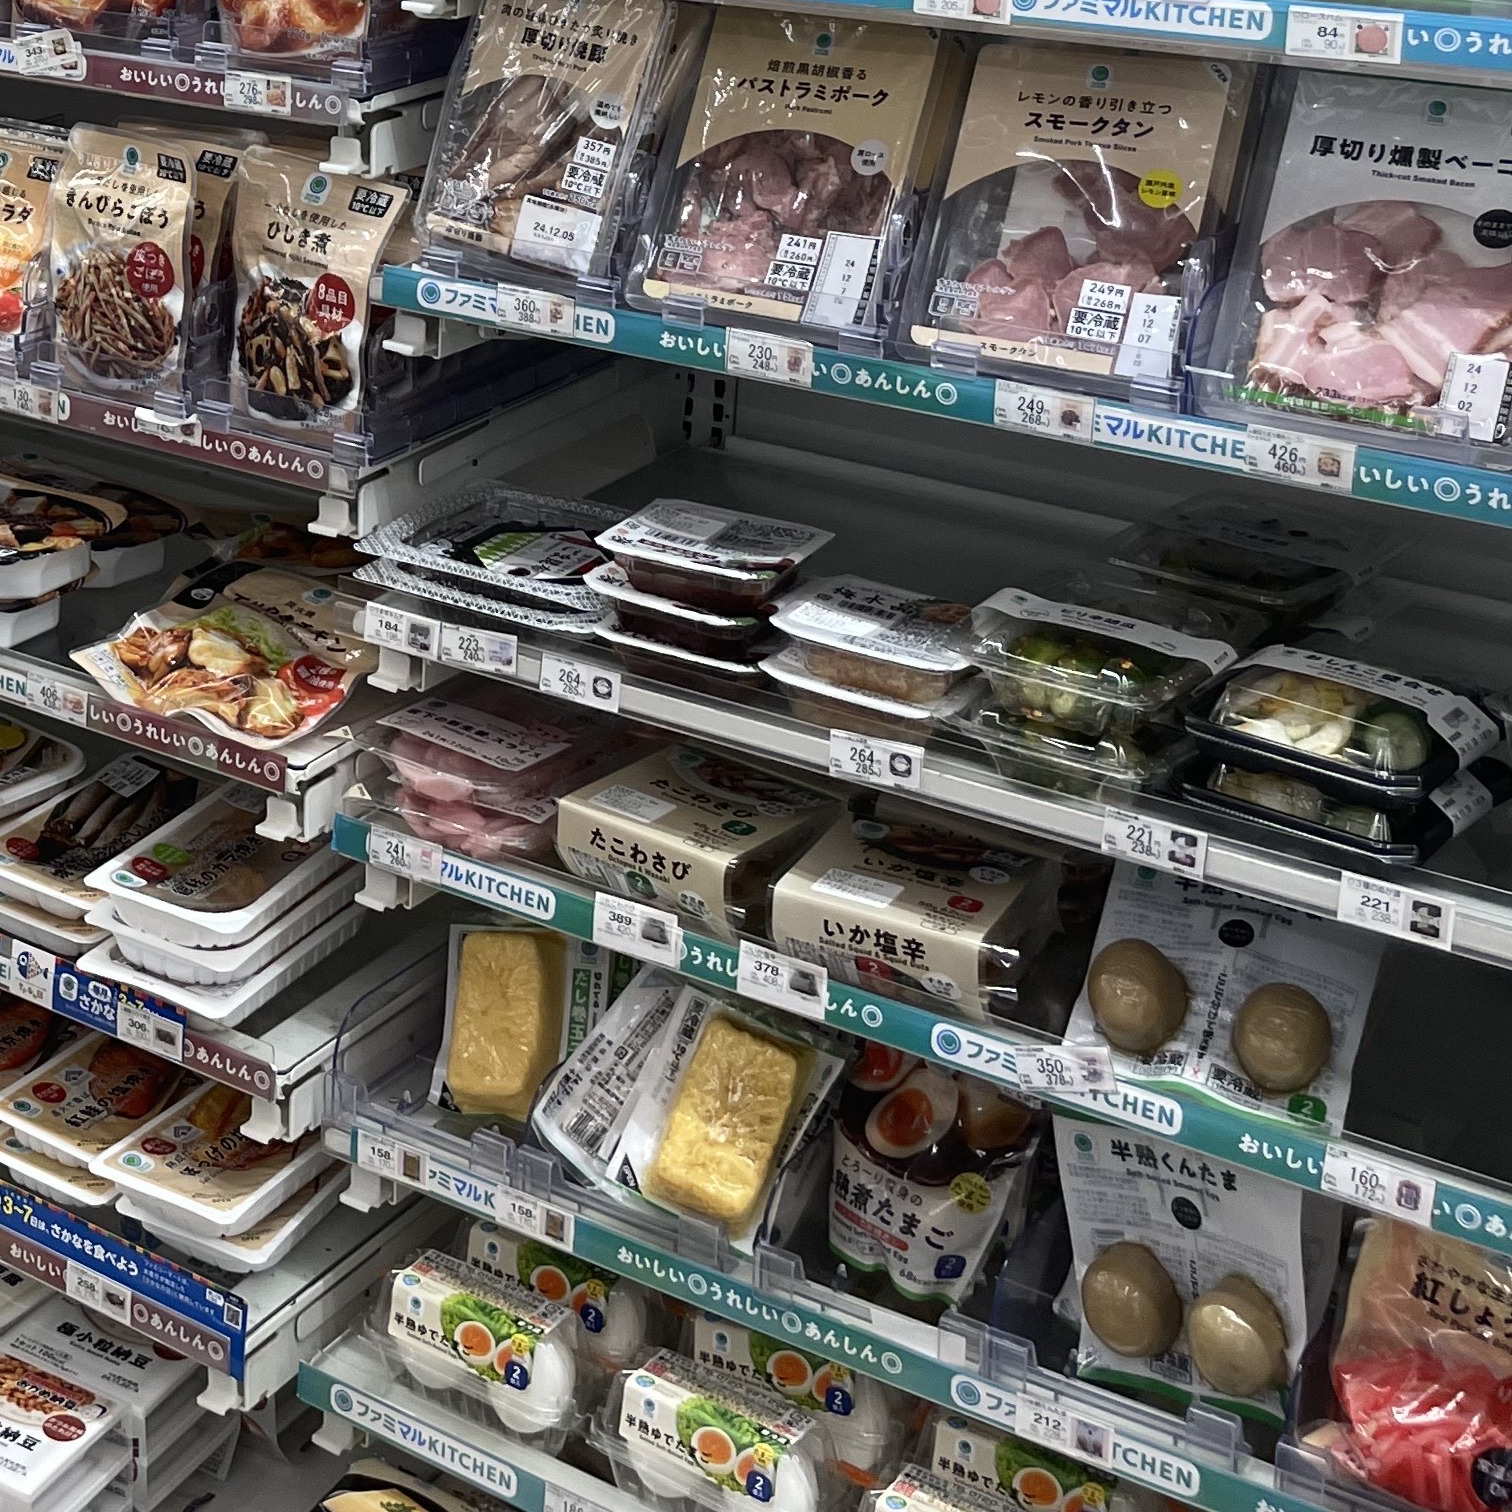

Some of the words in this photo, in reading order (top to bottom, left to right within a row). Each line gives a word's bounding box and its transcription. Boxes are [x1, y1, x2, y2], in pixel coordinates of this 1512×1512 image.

[737, 76, 890, 106] パストラミポーク
[1017, 90, 1173, 116] レモンの香り引き立つ
[1024, 111, 1155, 139] スモークタン
[66, 190, 169, 228] きんぴらごぼう
[267, 219, 332, 256] ひじき煮
[855, 369, 932, 399] あんしん
[590, 827, 691, 879] たこわさび
[822, 918, 927, 964] いか塩辛
[196, 1048, 253, 1080] あんしん
[617, 1246, 686, 1283] おいしい
[709, 1284, 780, 1322] うれしい
[804, 1320, 880, 1363] あんしん
[56, 1322, 153, 1369] 極小粒納豆
[355, 1397, 514, 1492] ファミマルKITCHEN
